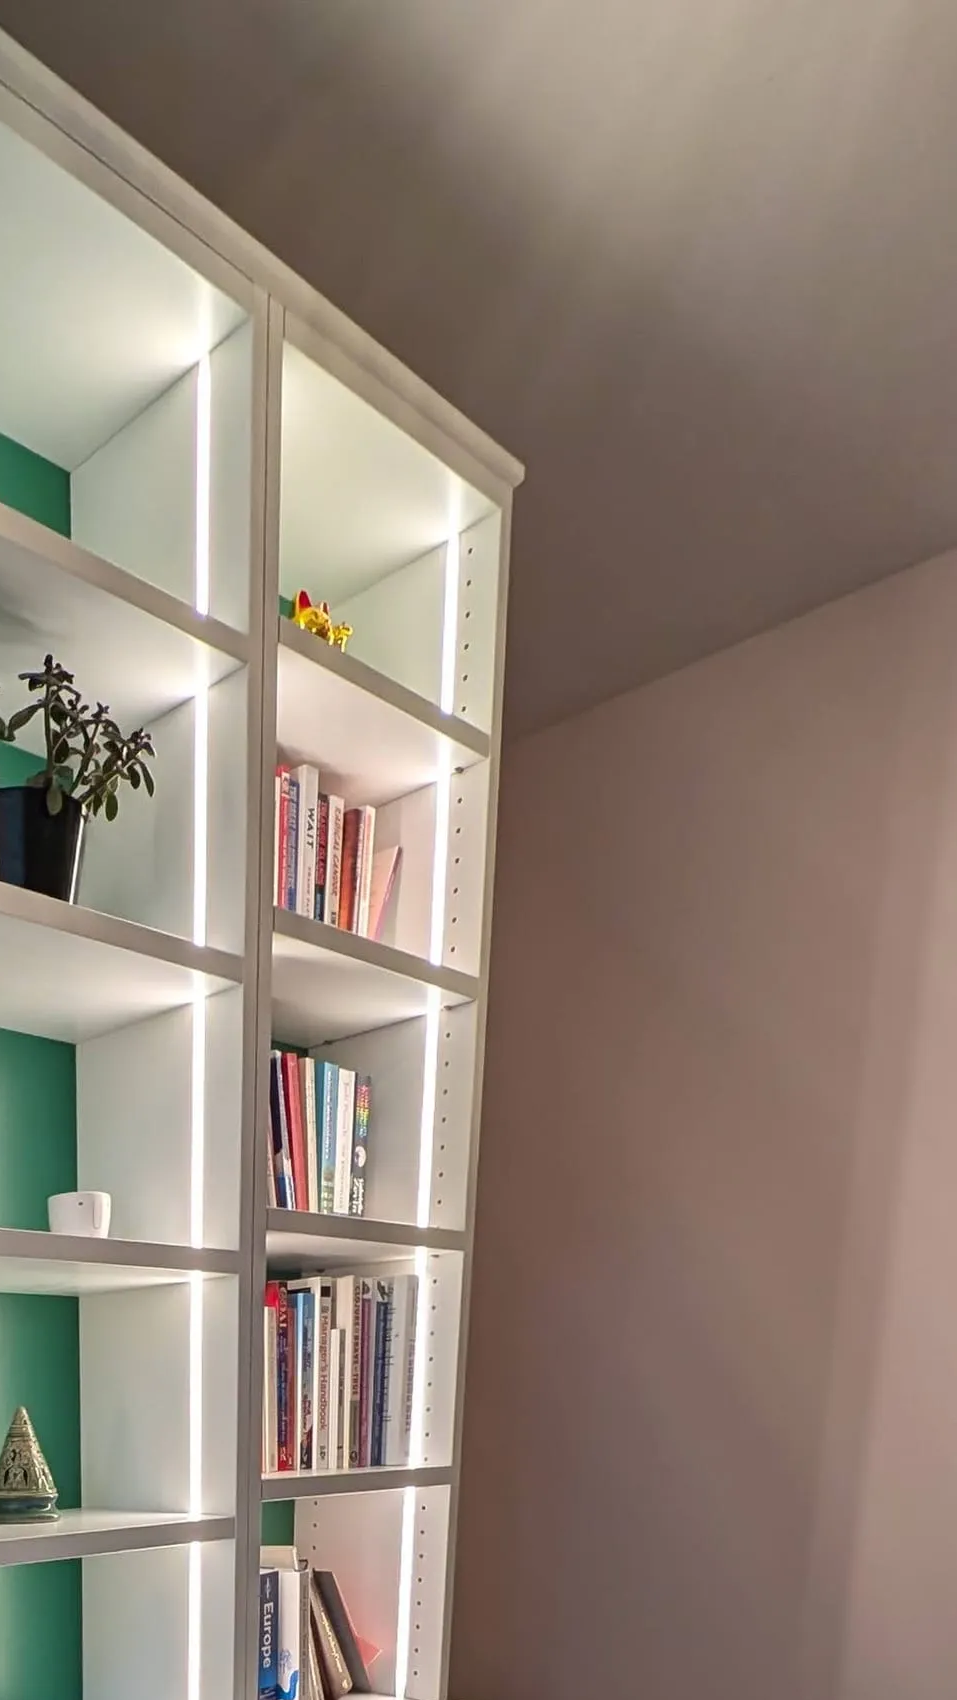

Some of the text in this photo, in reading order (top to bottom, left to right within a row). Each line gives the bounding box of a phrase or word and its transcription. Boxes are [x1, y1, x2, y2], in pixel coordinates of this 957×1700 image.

[307, 808, 316, 849] WAIT
[320, 1375, 328, 1431] Handbook
[262, 1602, 274, 1668] Europe
